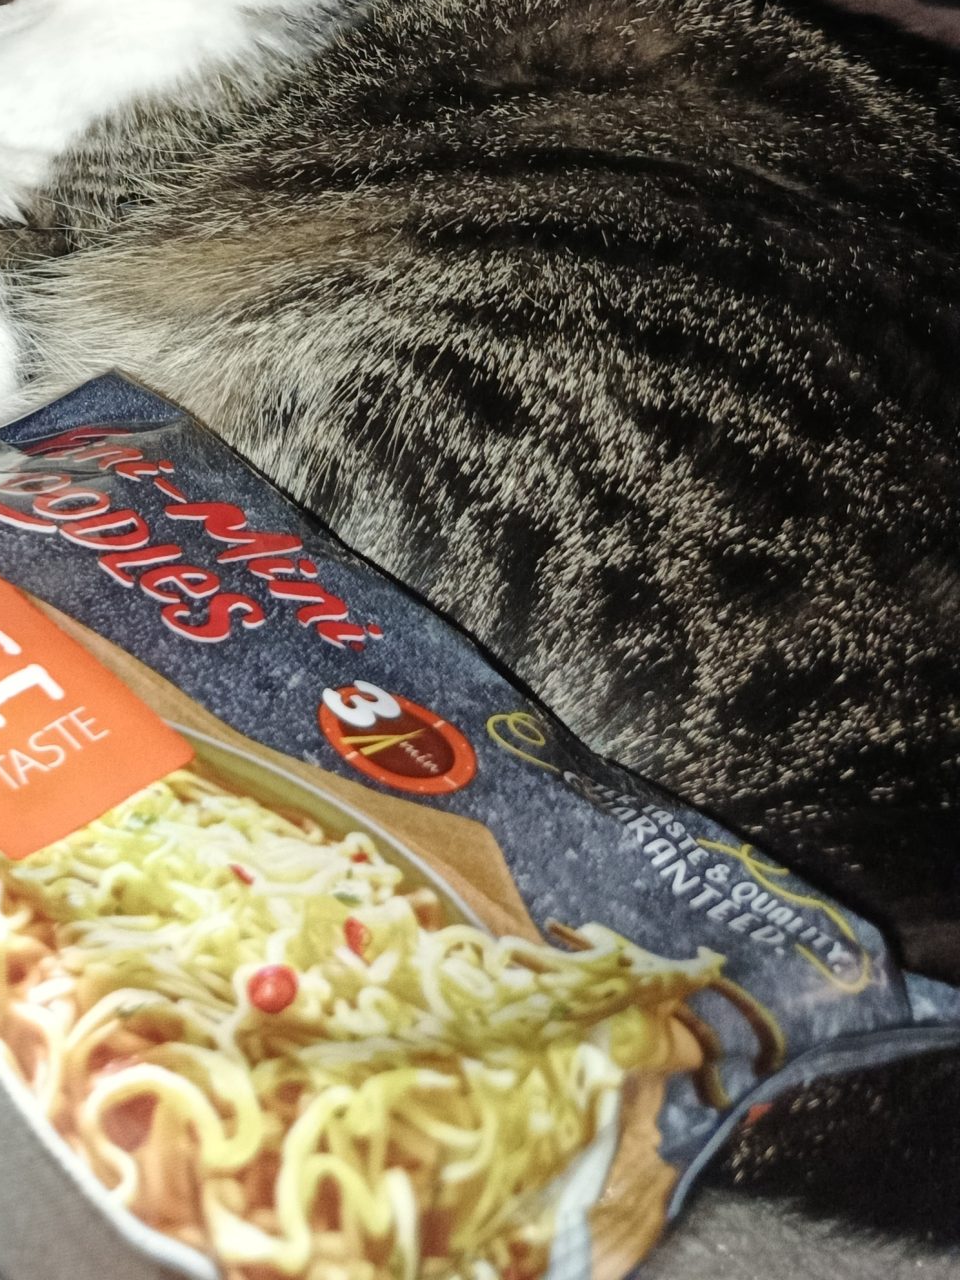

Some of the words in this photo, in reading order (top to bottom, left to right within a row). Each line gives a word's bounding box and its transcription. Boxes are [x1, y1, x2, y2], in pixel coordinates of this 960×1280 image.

[322, 679, 402, 728] 3
[399, 740, 440, 774] min
[705, 863, 731, 883] &
